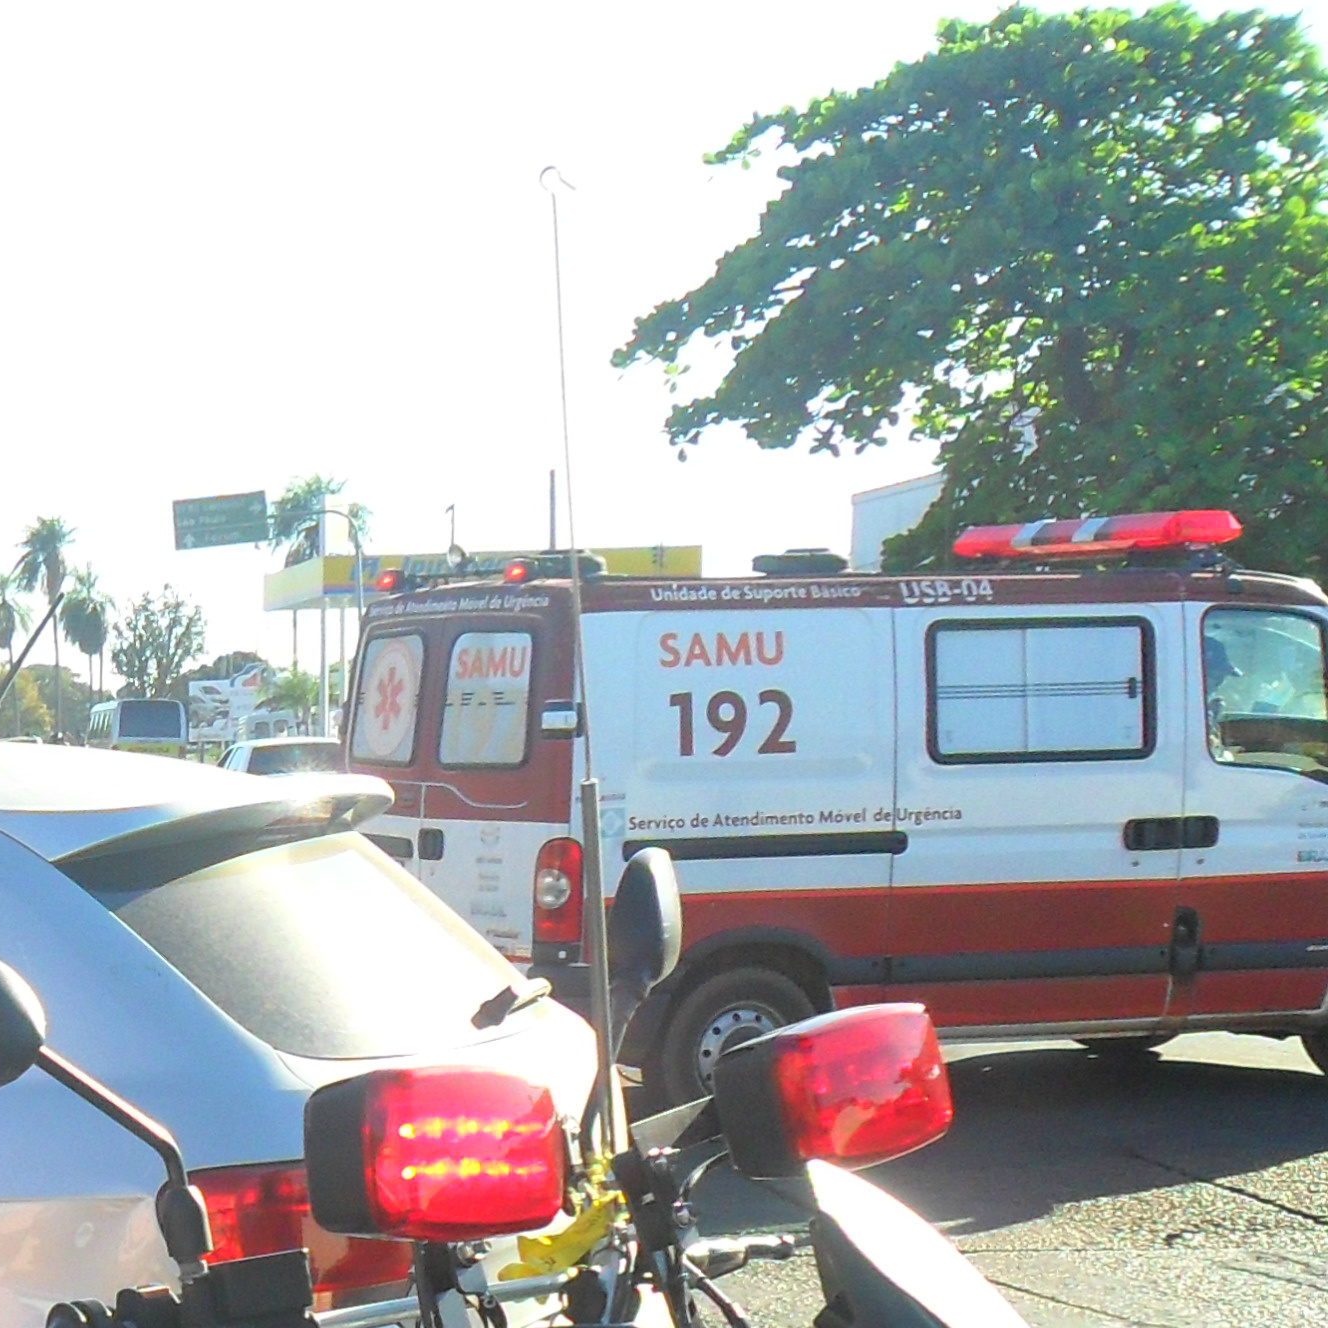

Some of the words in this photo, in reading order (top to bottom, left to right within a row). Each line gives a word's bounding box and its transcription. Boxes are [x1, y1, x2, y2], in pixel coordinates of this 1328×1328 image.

[490, 595, 502, 609] de
[650, 584, 716, 602] Unidade
[721, 586, 740, 600] de
[743, 585, 806, 603] Suporte
[899, 579, 994, 604] USB-04
[455, 646, 528, 680] SAMU
[657, 631, 785, 669] SAMU
[668, 688, 797, 757] 192
[628, 815, 686, 833] Serviço
[690, 813, 709, 829] de
[713, 811, 815, 829] Atendimento
[819, 806, 866, 824] Móvel
[873, 807, 893, 823] de
[897, 804, 963, 826] Urgência
